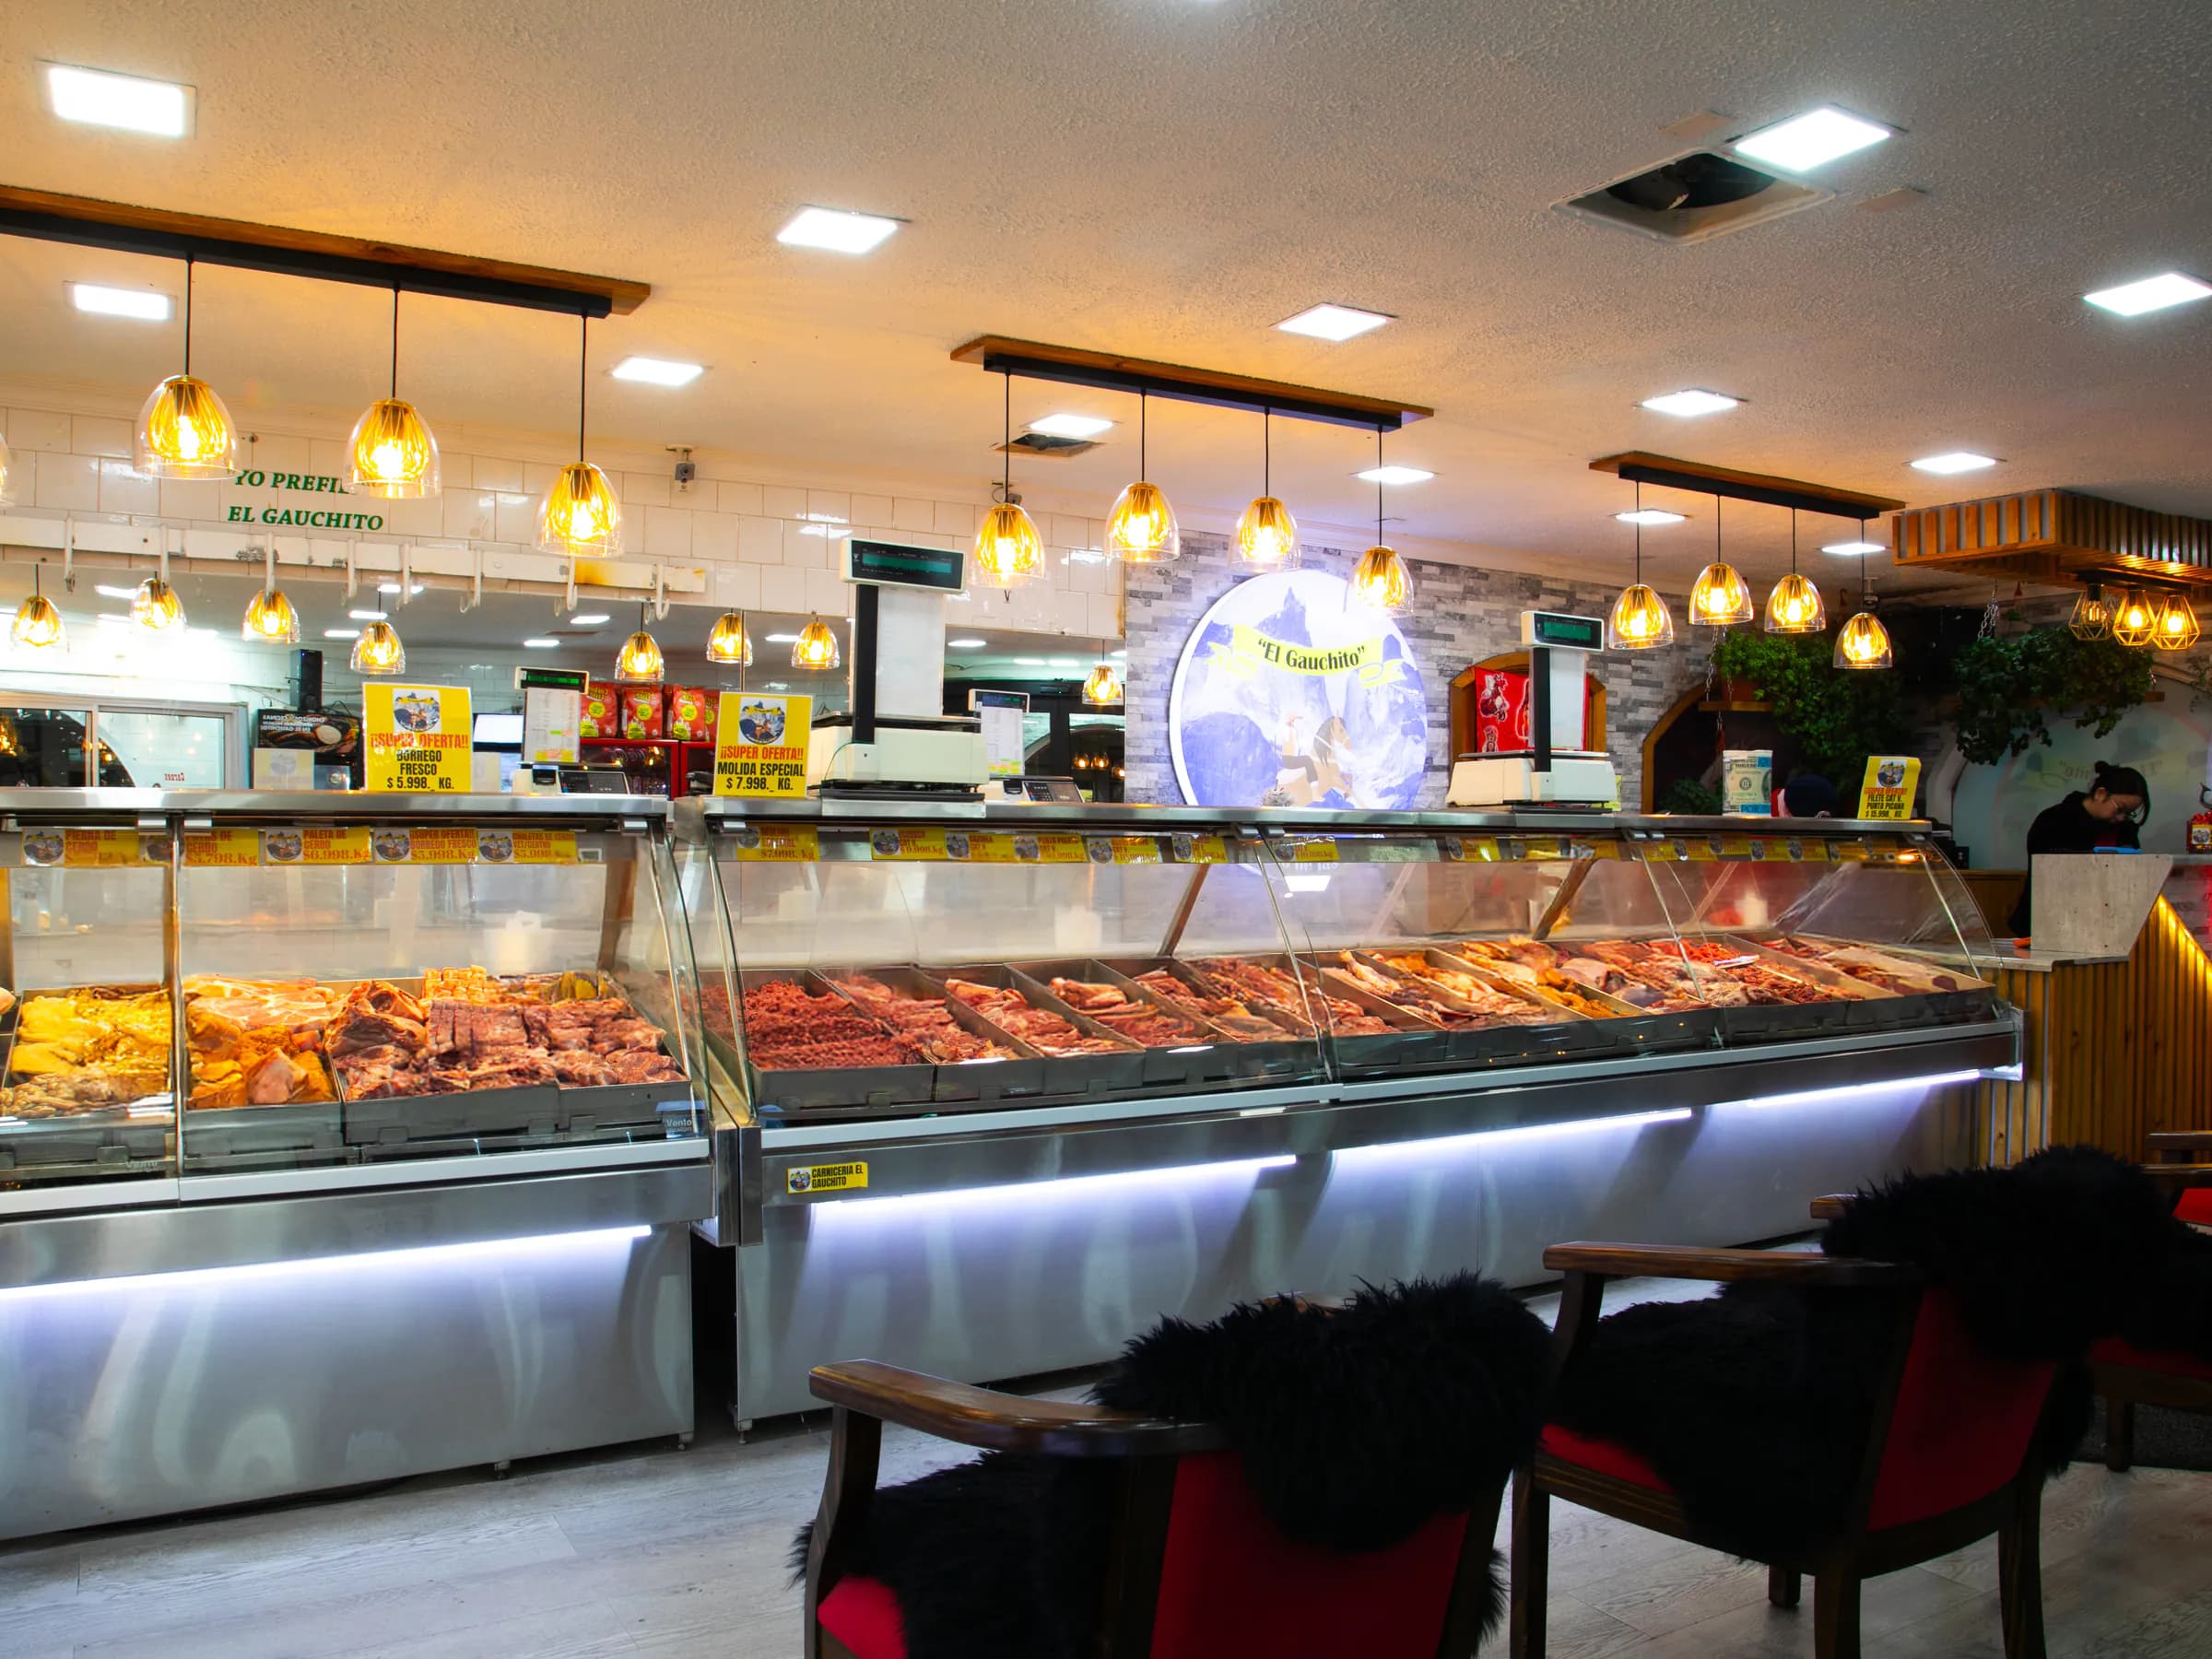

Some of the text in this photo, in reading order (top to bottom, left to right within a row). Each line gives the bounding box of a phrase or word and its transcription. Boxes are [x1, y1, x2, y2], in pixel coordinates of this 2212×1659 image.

[235, 470, 265, 487] YO
[227, 505, 384, 531] EL GAUCHITO
[418, 734, 469, 748] OFERTA!!
[396, 749, 442, 762] BORREGO
[761, 747, 805, 760] OFERTA!!
[400, 762, 438, 775] FRESCO
[717, 761, 805, 777] MOLIDA ESPECIAL
[387, 777, 394, 789] $
[438, 777, 454, 790] KG.
[726, 777, 734, 790] $
[777, 777, 794, 791] KG.
[665, 1118, 692, 1127] Vento
[811, 1165, 864, 1178] CARNICERIA EL
[811, 1176, 847, 1188] GAUCHITO
